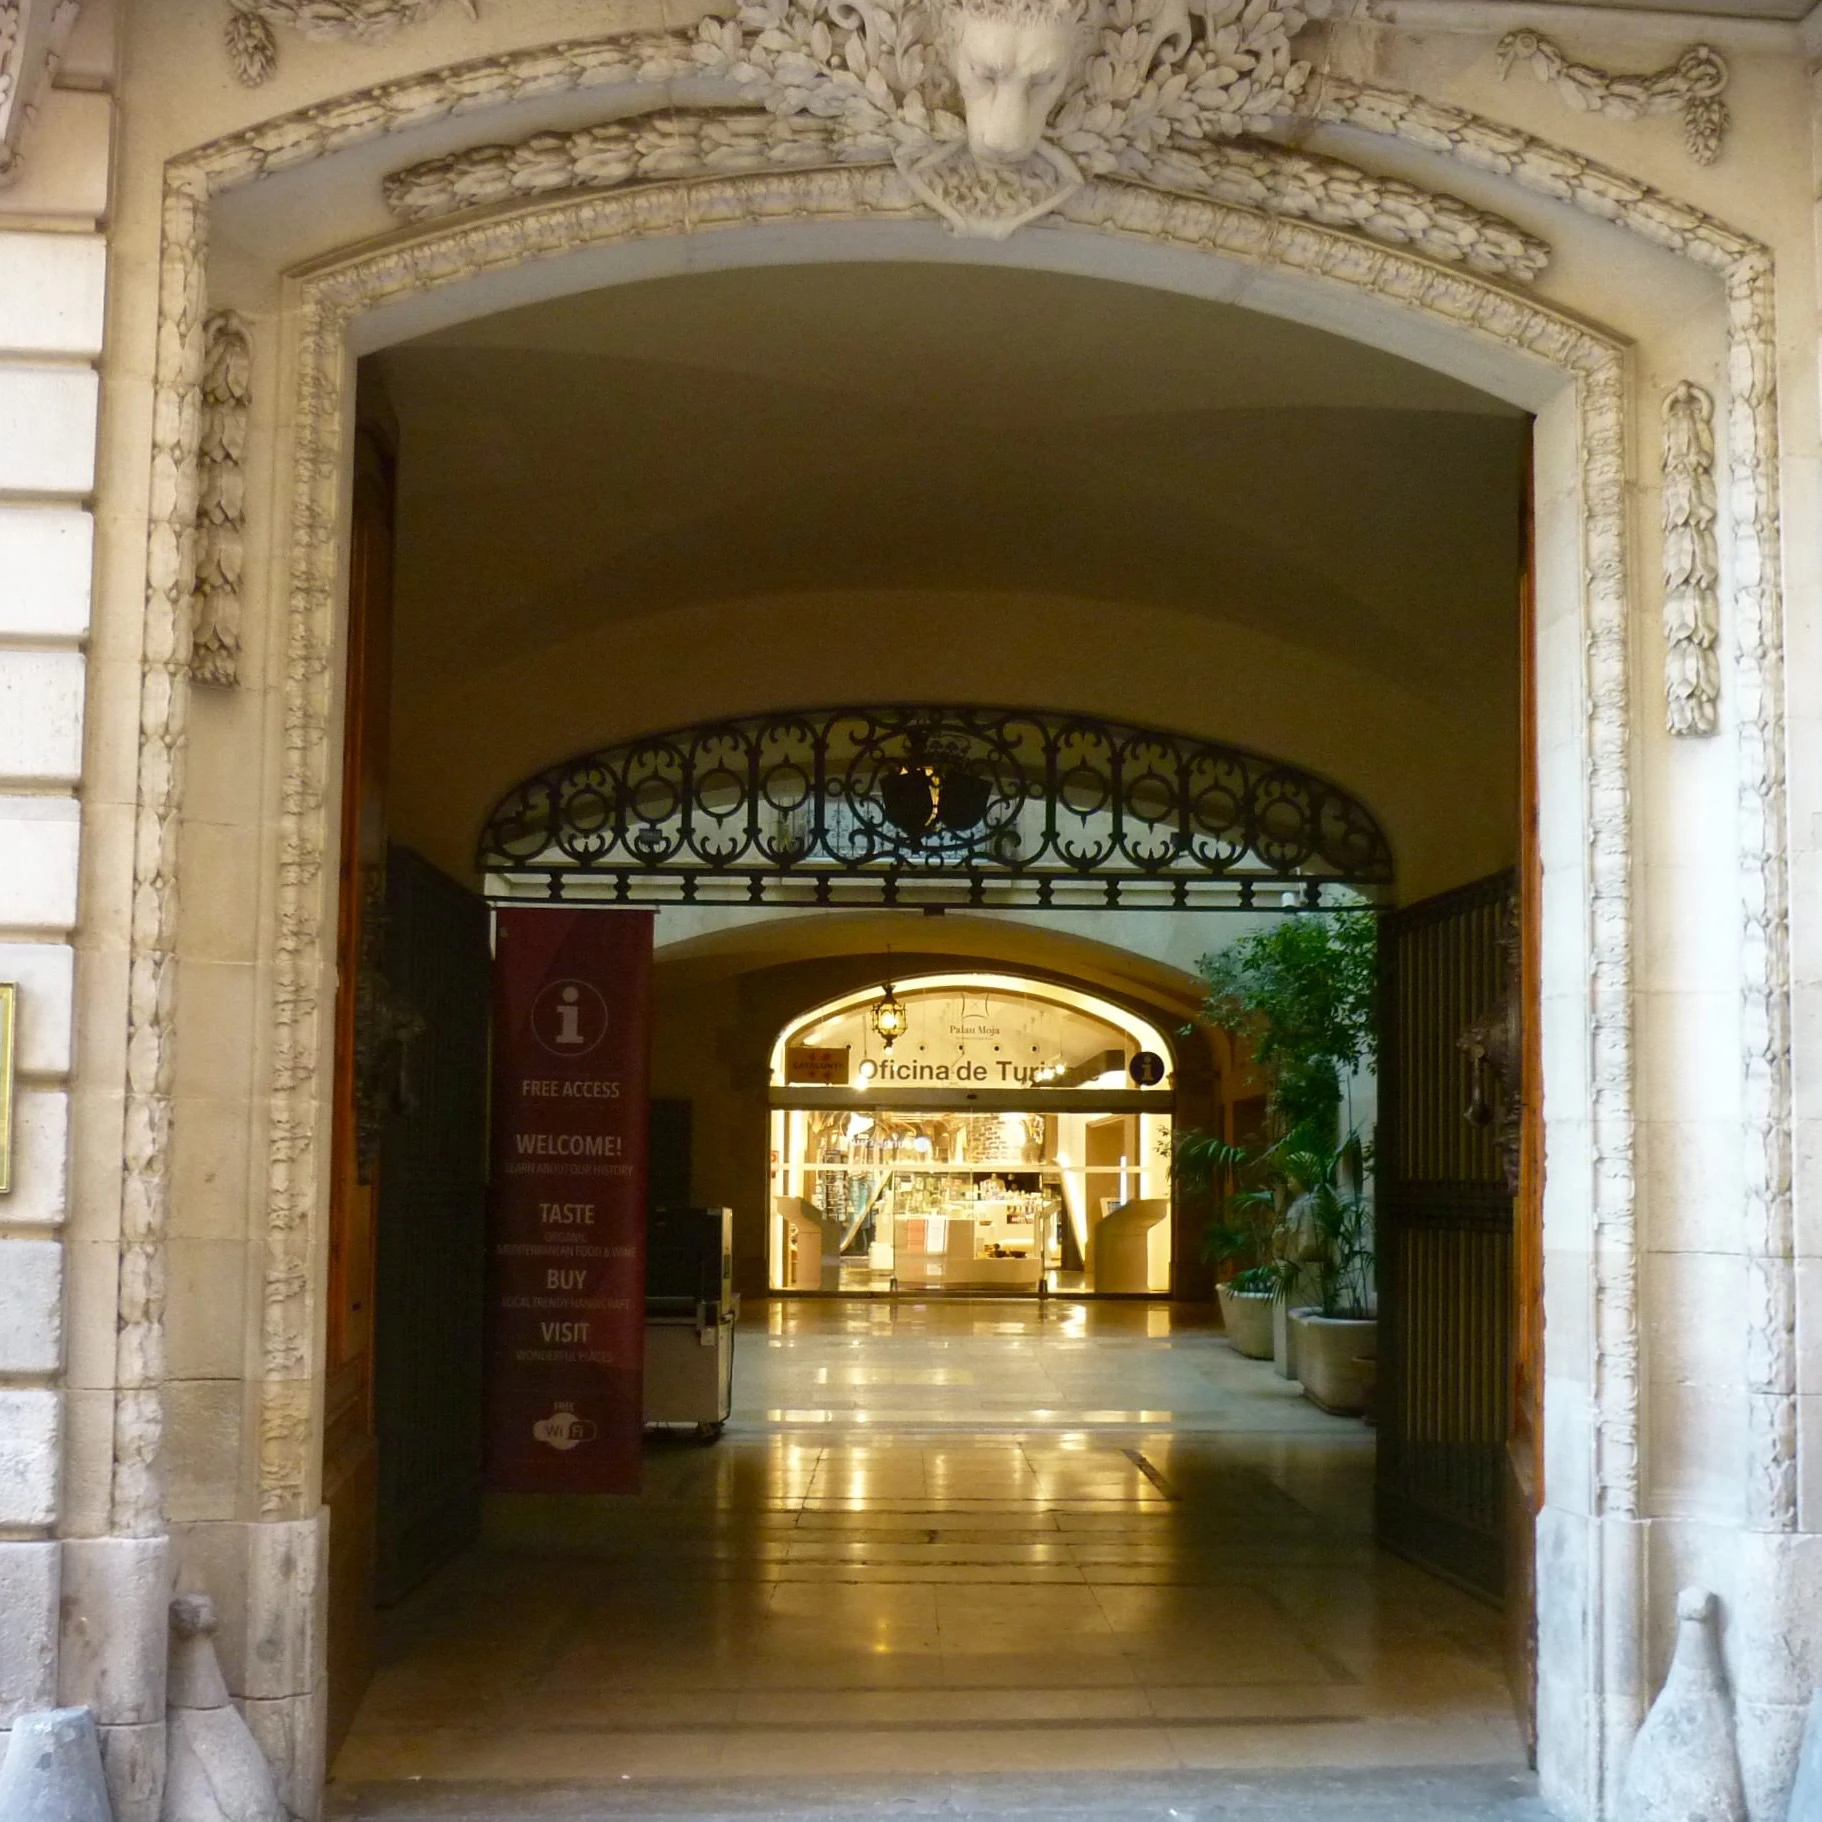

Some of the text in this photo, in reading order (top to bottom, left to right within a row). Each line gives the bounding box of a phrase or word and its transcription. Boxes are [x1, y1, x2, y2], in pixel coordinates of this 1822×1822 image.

[949, 1024, 1000, 1036] Palau Moja
[859, 1059, 949, 1080] Oficina
[956, 1061, 987, 1080] de
[522, 1080, 621, 1098] FREE ACCESS
[516, 1134, 622, 1156] WELCOME!
[537, 1163, 568, 1175] ABOUT
[593, 1164, 634, 1176] HISTORY
[539, 1203, 595, 1224] TASTE
[576, 1245, 602, 1257] FOOD
[546, 1269, 587, 1290] BUY
[540, 1322, 591, 1343] VISIT
[515, 1350, 576, 1362] WONDERFUL
